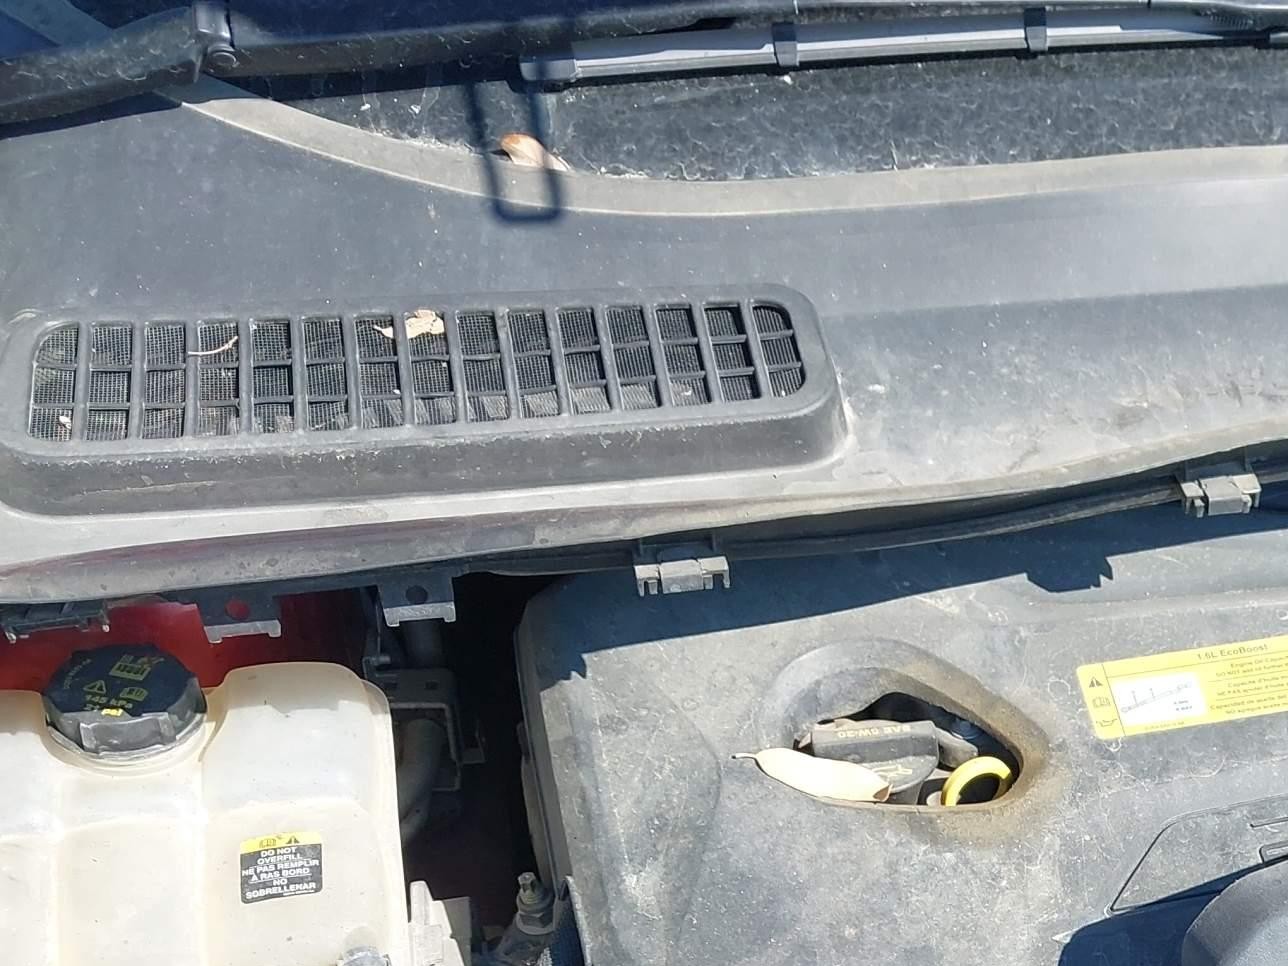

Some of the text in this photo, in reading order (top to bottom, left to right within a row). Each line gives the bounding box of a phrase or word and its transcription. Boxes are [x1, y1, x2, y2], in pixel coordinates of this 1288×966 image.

[277, 847, 297, 855] NOT
[257, 853, 303, 865] OVERFILL
[242, 860, 319, 876] NE PAS REMPLIR
[260, 871, 280, 880] RAS
[282, 868, 310, 877] BORD
[273, 878, 288, 886] NO
[245, 882, 316, 899] SOBRELLENAR
